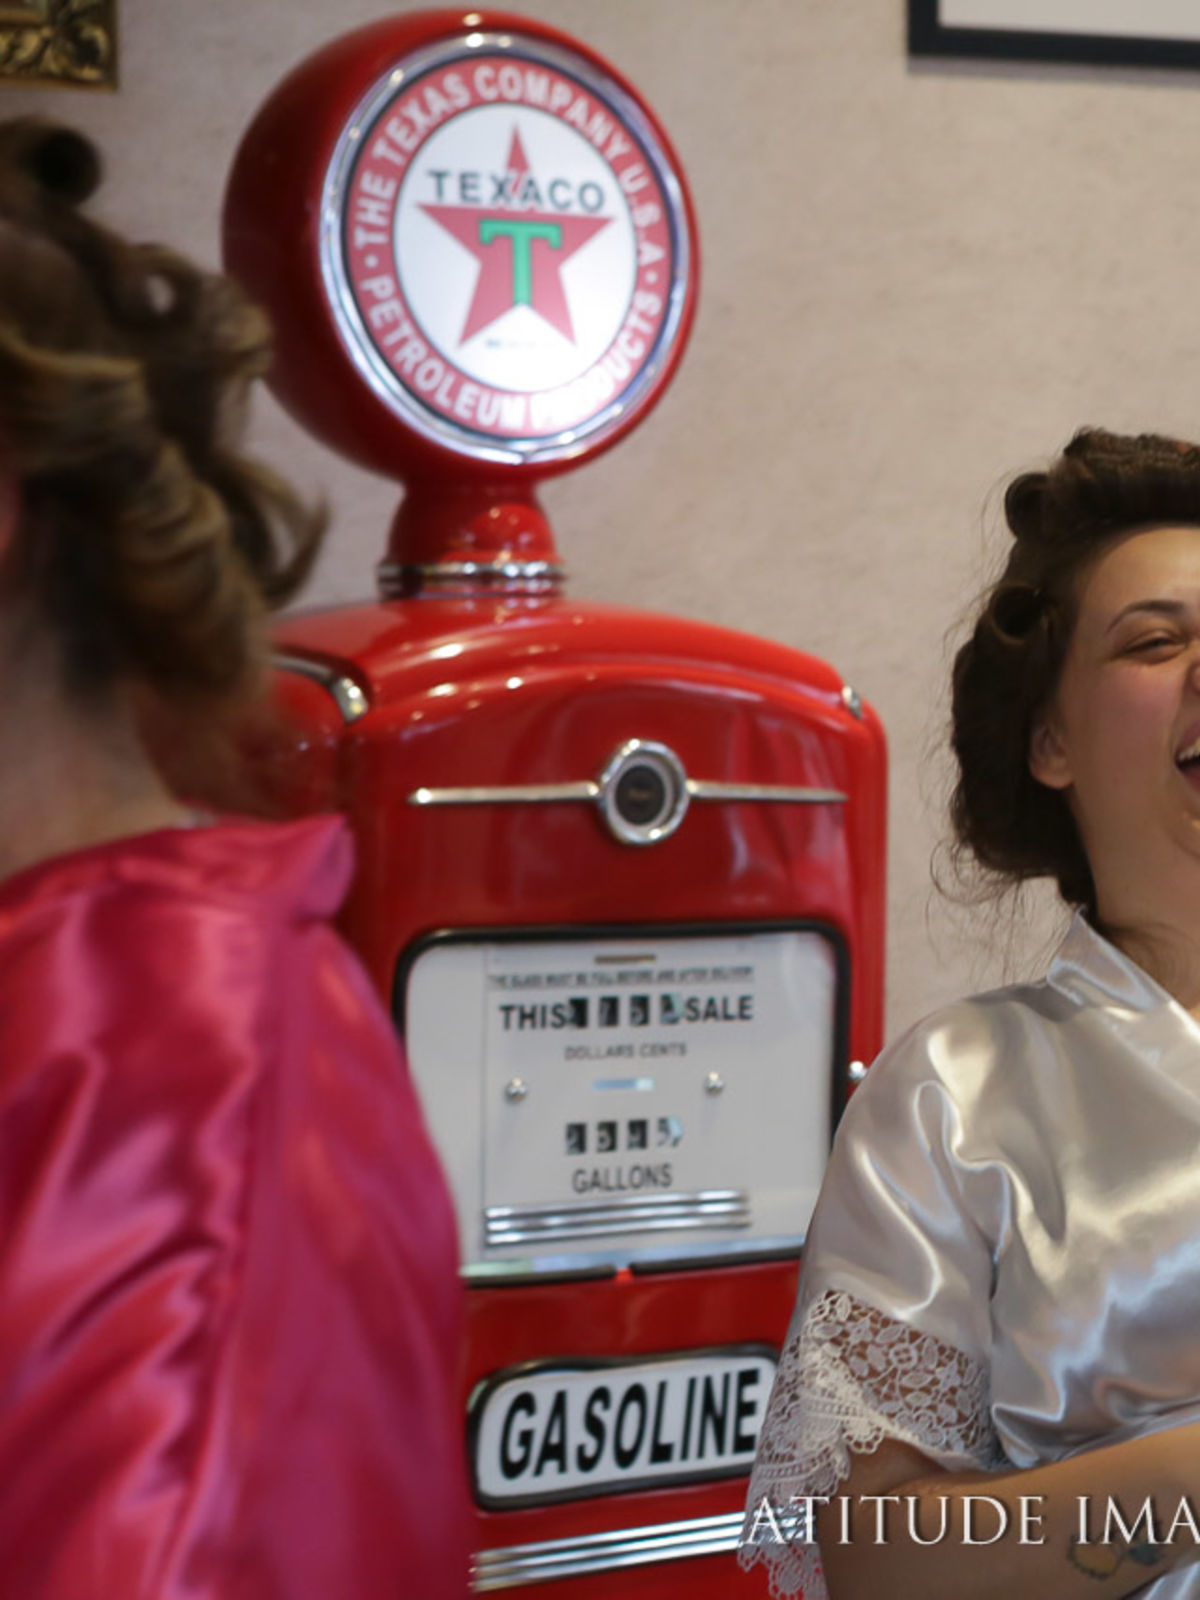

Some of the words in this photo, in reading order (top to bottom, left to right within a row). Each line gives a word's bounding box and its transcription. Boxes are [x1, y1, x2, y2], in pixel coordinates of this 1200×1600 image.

[371, 73, 473, 160] TEXAS
[474, 65, 631, 160] COMPANY
[354, 171, 396, 248] THE
[427, 169, 605, 213] TEXACO
[479, 218, 562, 307] T
[360, 276, 527, 430] PETROLEUM
[530, 290, 663, 430] DUCTS
[499, 1003, 567, 1030] THIS
[685, 994, 753, 1021] SALE
[565, 1045, 634, 1061] DOLLARS
[640, 1042, 686, 1058] CENTS
[571, 1162, 673, 1194] GALLONS
[499, 1367, 761, 1481] GASOLINE
